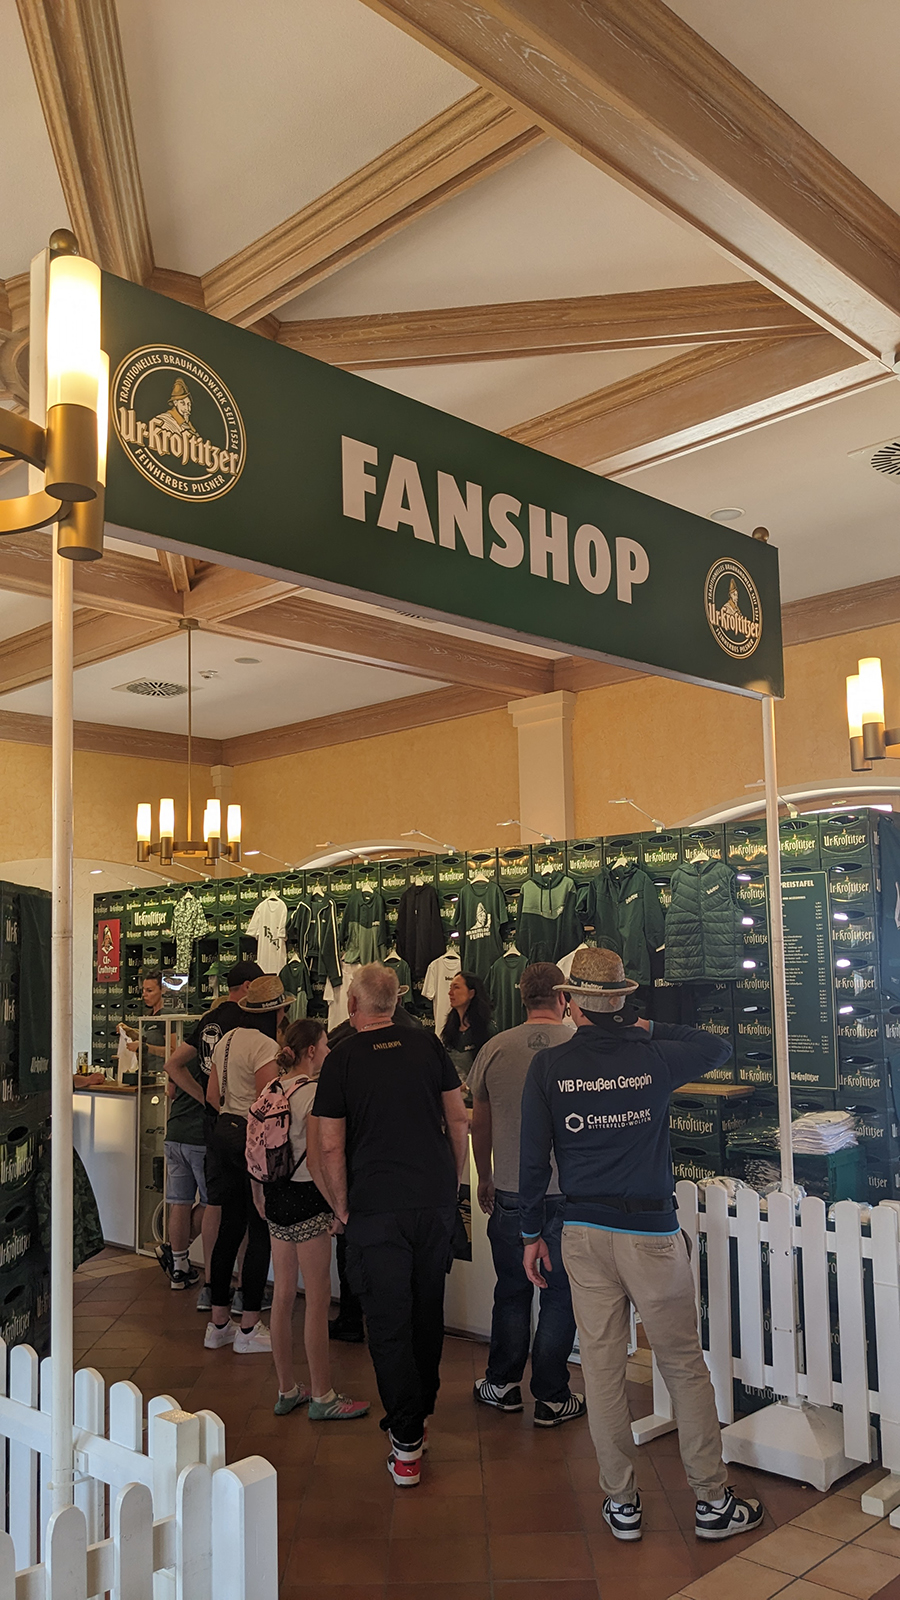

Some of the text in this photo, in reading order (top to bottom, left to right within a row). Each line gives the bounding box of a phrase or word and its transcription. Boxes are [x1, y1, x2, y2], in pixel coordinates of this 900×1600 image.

[119, 354, 240, 450] TRADITIONELLES BRAUHANDWERK SEIT 1534
[134, 448, 226, 494] FEINHERBES PILSNER
[341, 434, 650, 605] FANSHOP
[780, 879, 815, 889] REISTAFEL
[557, 1072, 652, 1094] VfB Preußen Greppin
